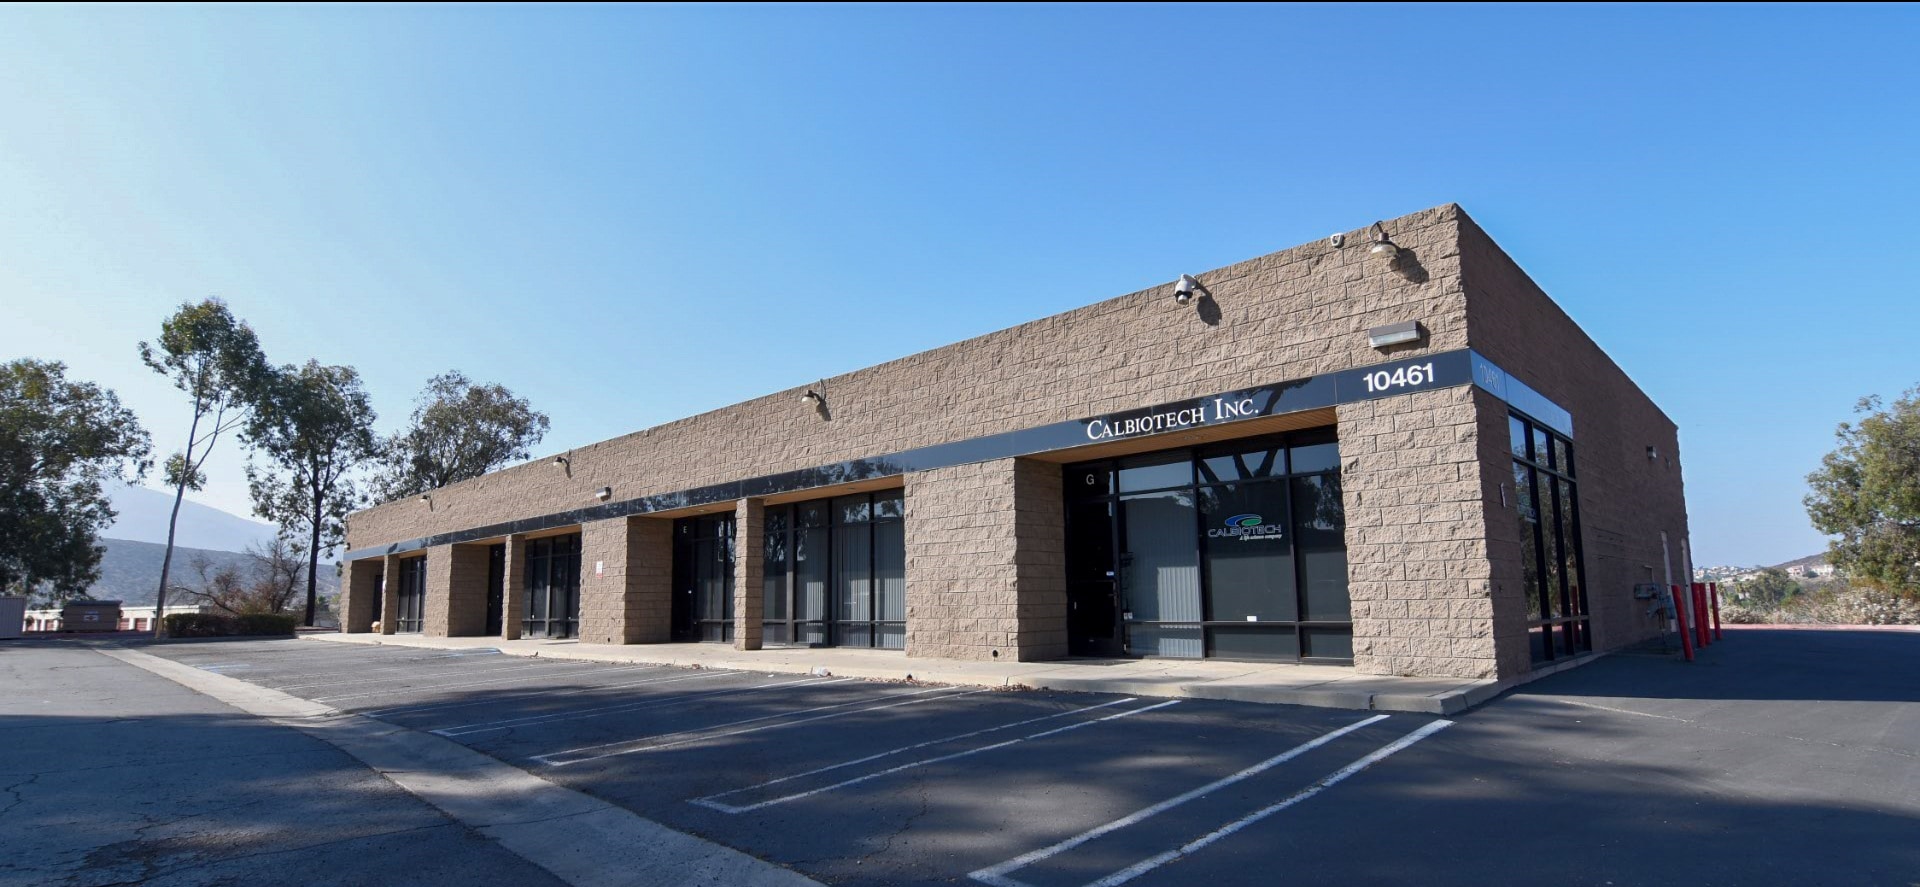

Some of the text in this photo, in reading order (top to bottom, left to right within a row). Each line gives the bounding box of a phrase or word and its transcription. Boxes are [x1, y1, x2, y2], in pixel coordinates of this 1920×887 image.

[1363, 362, 1434, 393] 10461
[1087, 407, 1205, 440] CALBIOTECH
[1086, 474, 1095, 485] G
[1208, 524, 1282, 537] CALBIOTECH
